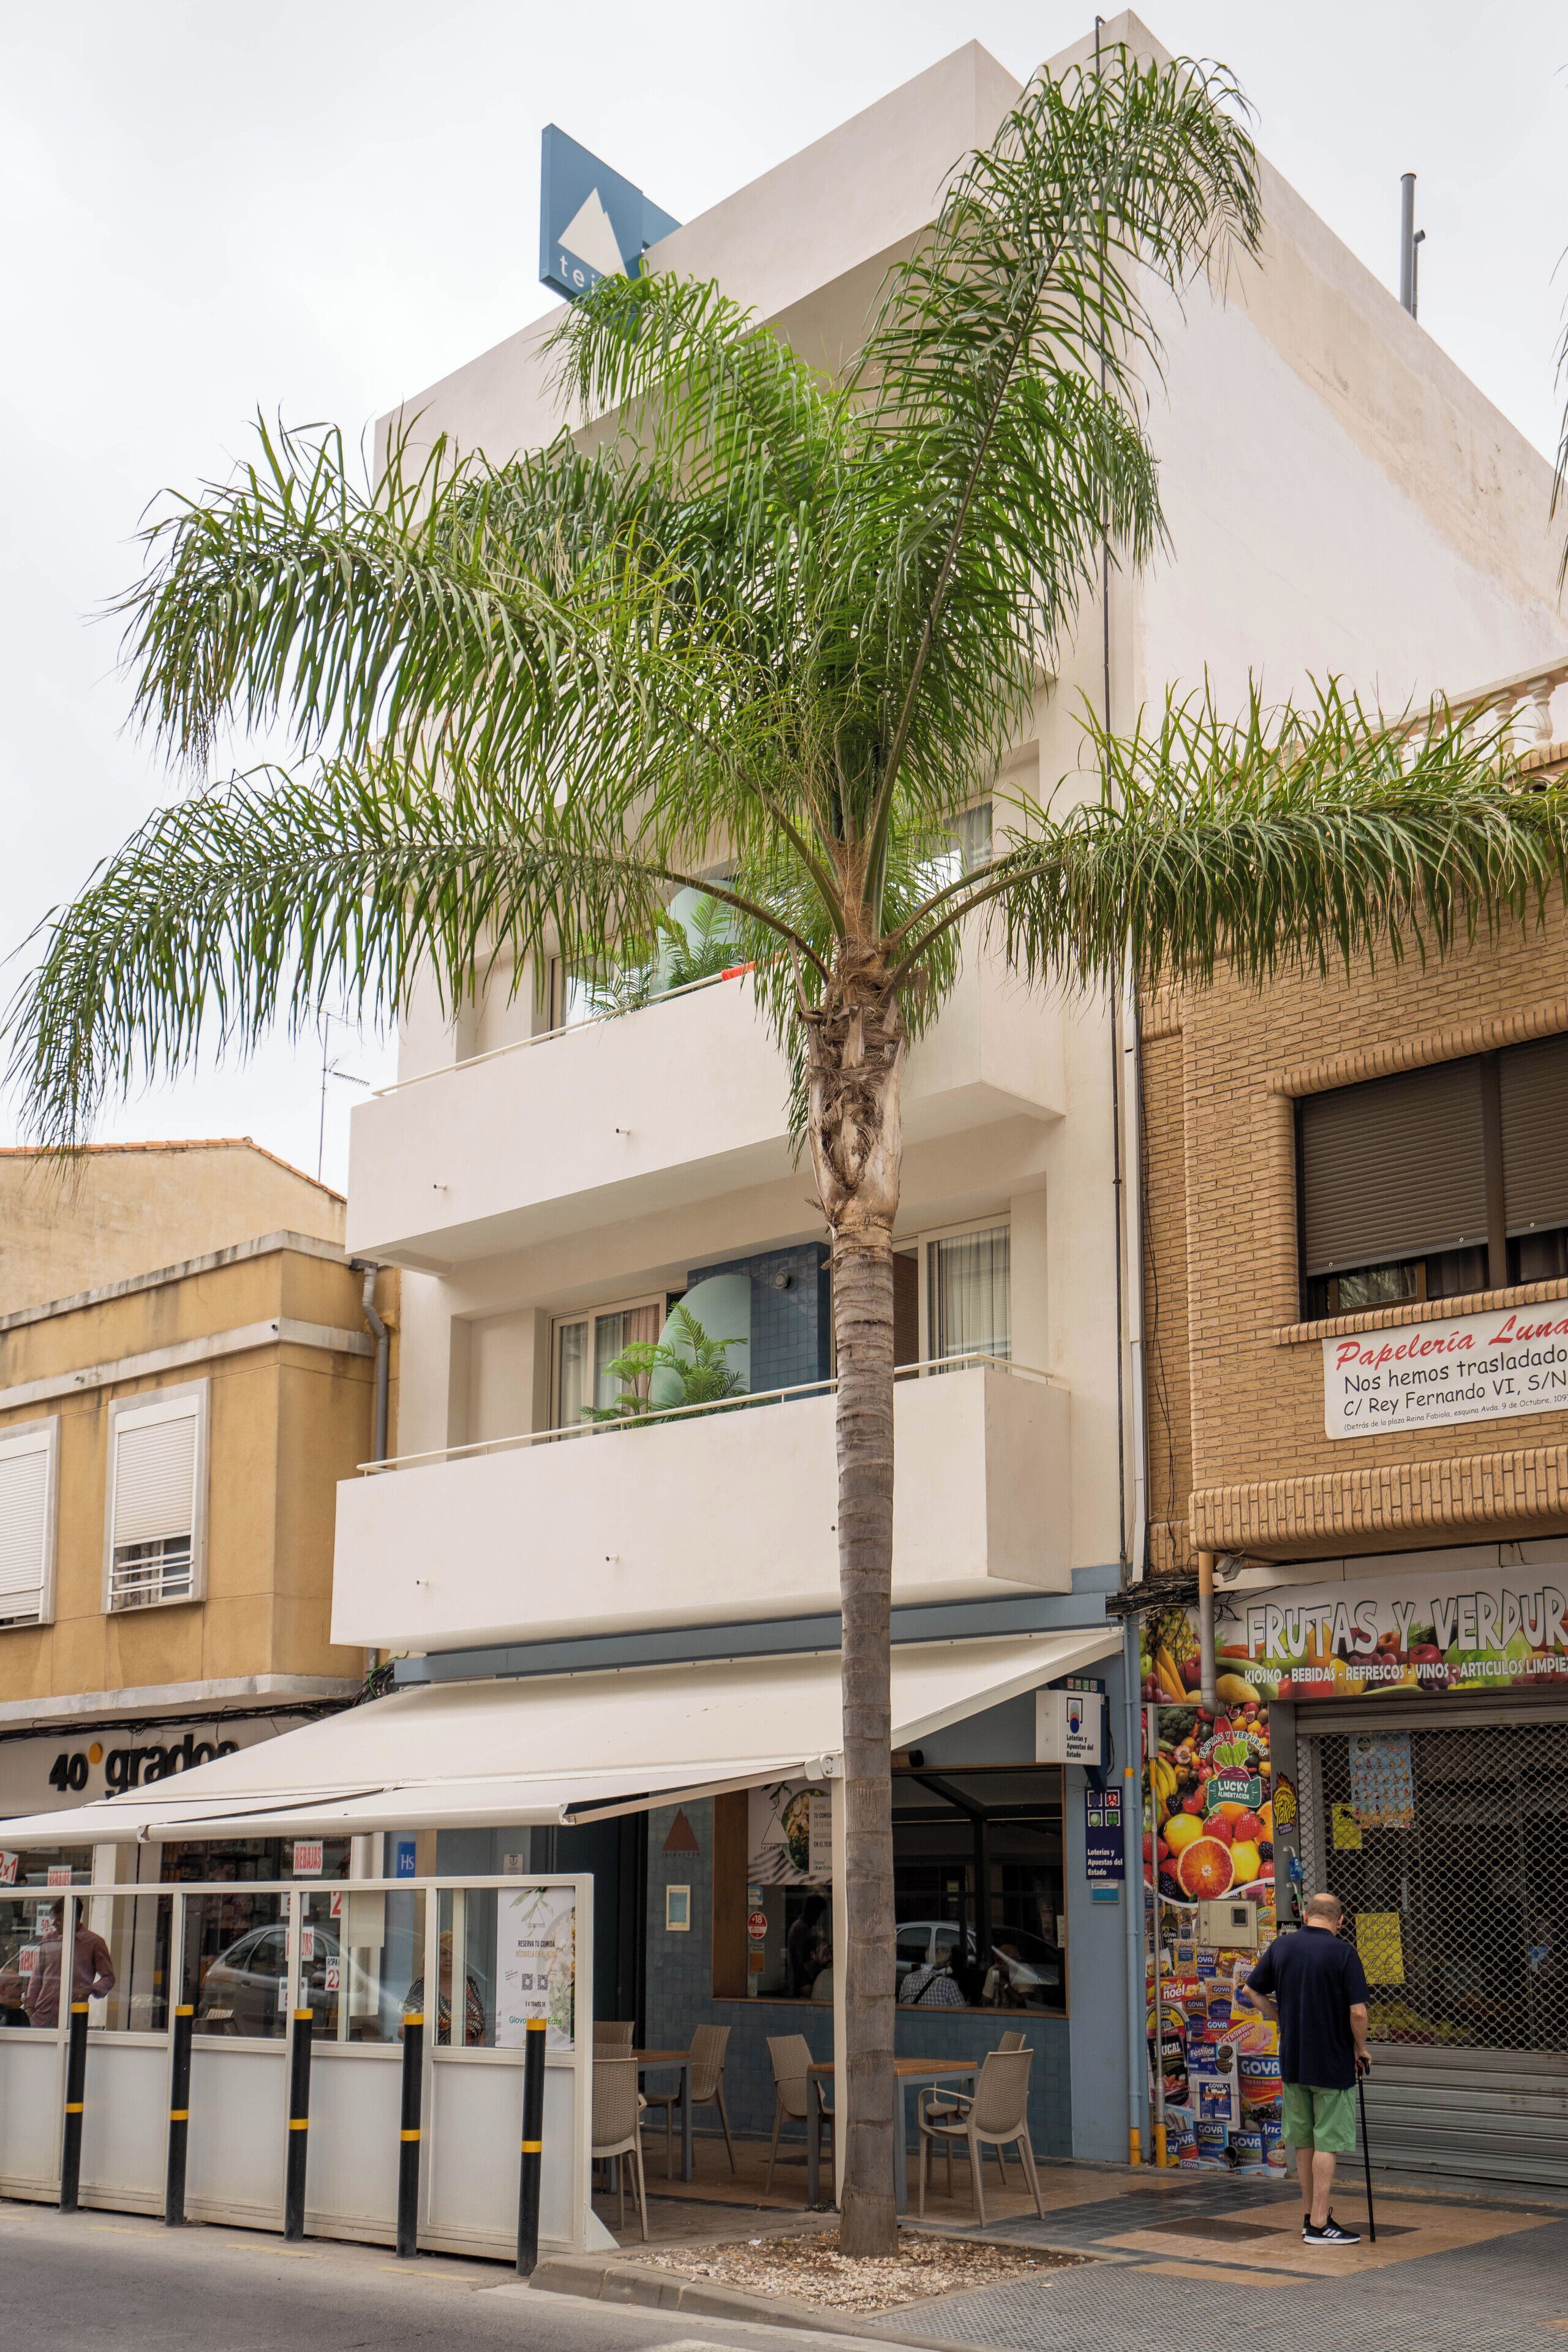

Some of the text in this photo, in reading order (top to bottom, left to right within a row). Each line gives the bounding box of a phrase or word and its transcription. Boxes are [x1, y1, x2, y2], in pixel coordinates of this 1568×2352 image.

[1335, 1314, 1568, 1371] Papelería Luna
[1344, 1344, 1567, 1394] Nos hemos trasladado
[1344, 1370, 1567, 1416] C/ Rey Fernando VI, S/N
[1344, 1420, 1369, 1432] (Detrás
[1380, 1418, 1387, 1427] la
[1388, 1416, 1405, 1427] plaza
[1406, 1414, 1425, 1423] Reina
[1427, 1409, 1452, 1422] Fabiola,
[1453, 1408, 1479, 1418] esquina
[1519, 1397, 1551, 1407] Octubre,
[1246, 1586, 1568, 1660] FRUTAS Y VERDUR
[1244, 1667, 1282, 1684] KIOSKO
[1291, 1666, 1335, 1683] BEBIDAS
[1345, 1664, 1404, 1680] REFRESCOS
[1415, 1661, 1449, 1679] VINOS
[1460, 1657, 1523, 1677] ARTICULOS
[1525, 1656, 1568, 1674] LIMPIE
[1199, 1733, 1224, 1758] FRUTAS
[1233, 1731, 1268, 1756] VERDURAS
[1218, 1780, 1249, 1793] LUCKY
[1275, 1800, 1297, 1829] Takis
[295, 1846, 322, 1870] REBAJAS
[401, 1855, 414, 1870] HS
[752, 1915, 763, 1923] +18
[1164, 1983, 1185, 2000] noel
[509, 2016, 527, 2024] Glovo
[1190, 2046, 1214, 2057] Festival
[1241, 2060, 1280, 2075] GOYA
[1198, 2125, 1223, 2134] GOYA
[1231, 2136, 1261, 2147] GOYA
